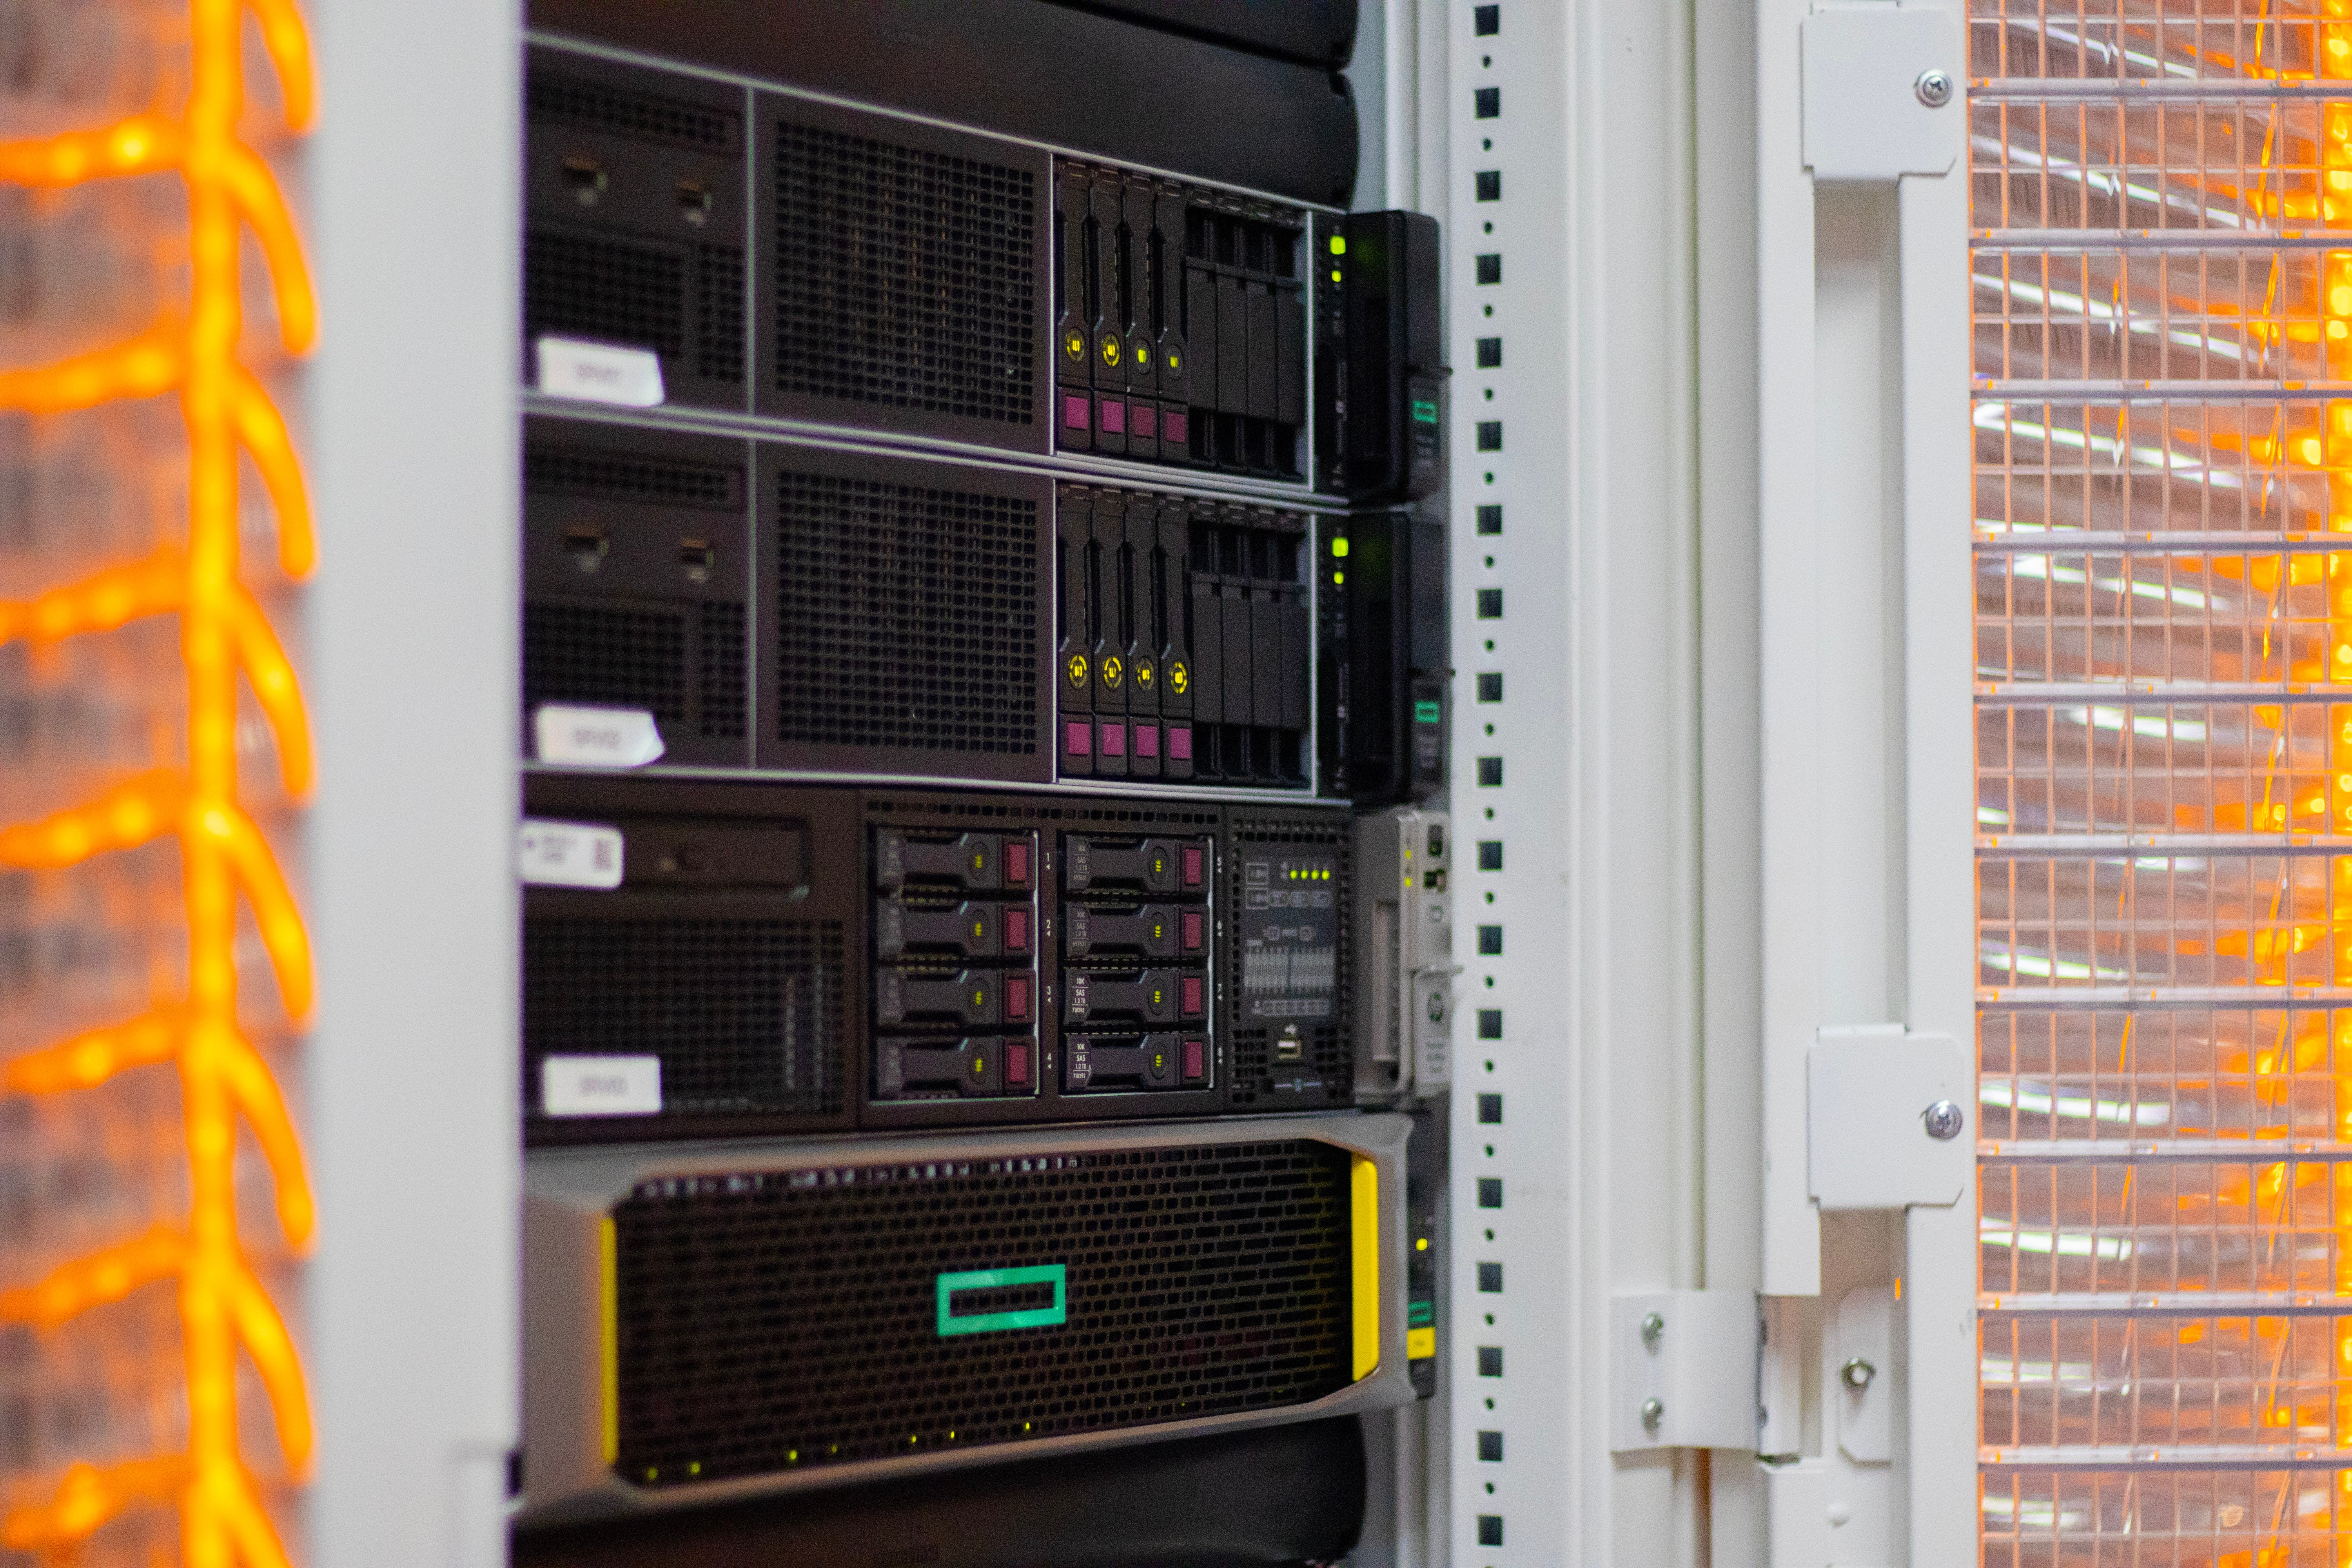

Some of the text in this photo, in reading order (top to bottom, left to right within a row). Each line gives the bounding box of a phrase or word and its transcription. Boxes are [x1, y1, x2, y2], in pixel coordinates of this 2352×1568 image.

[1047, 853, 1049, 862] 1
[1217, 857, 1221, 866] 5
[1046, 919, 1051, 929] 2
[1047, 985, 1051, 995] 3
[1217, 983, 1222, 993] 7
[1047, 1052, 1051, 1062] 4
